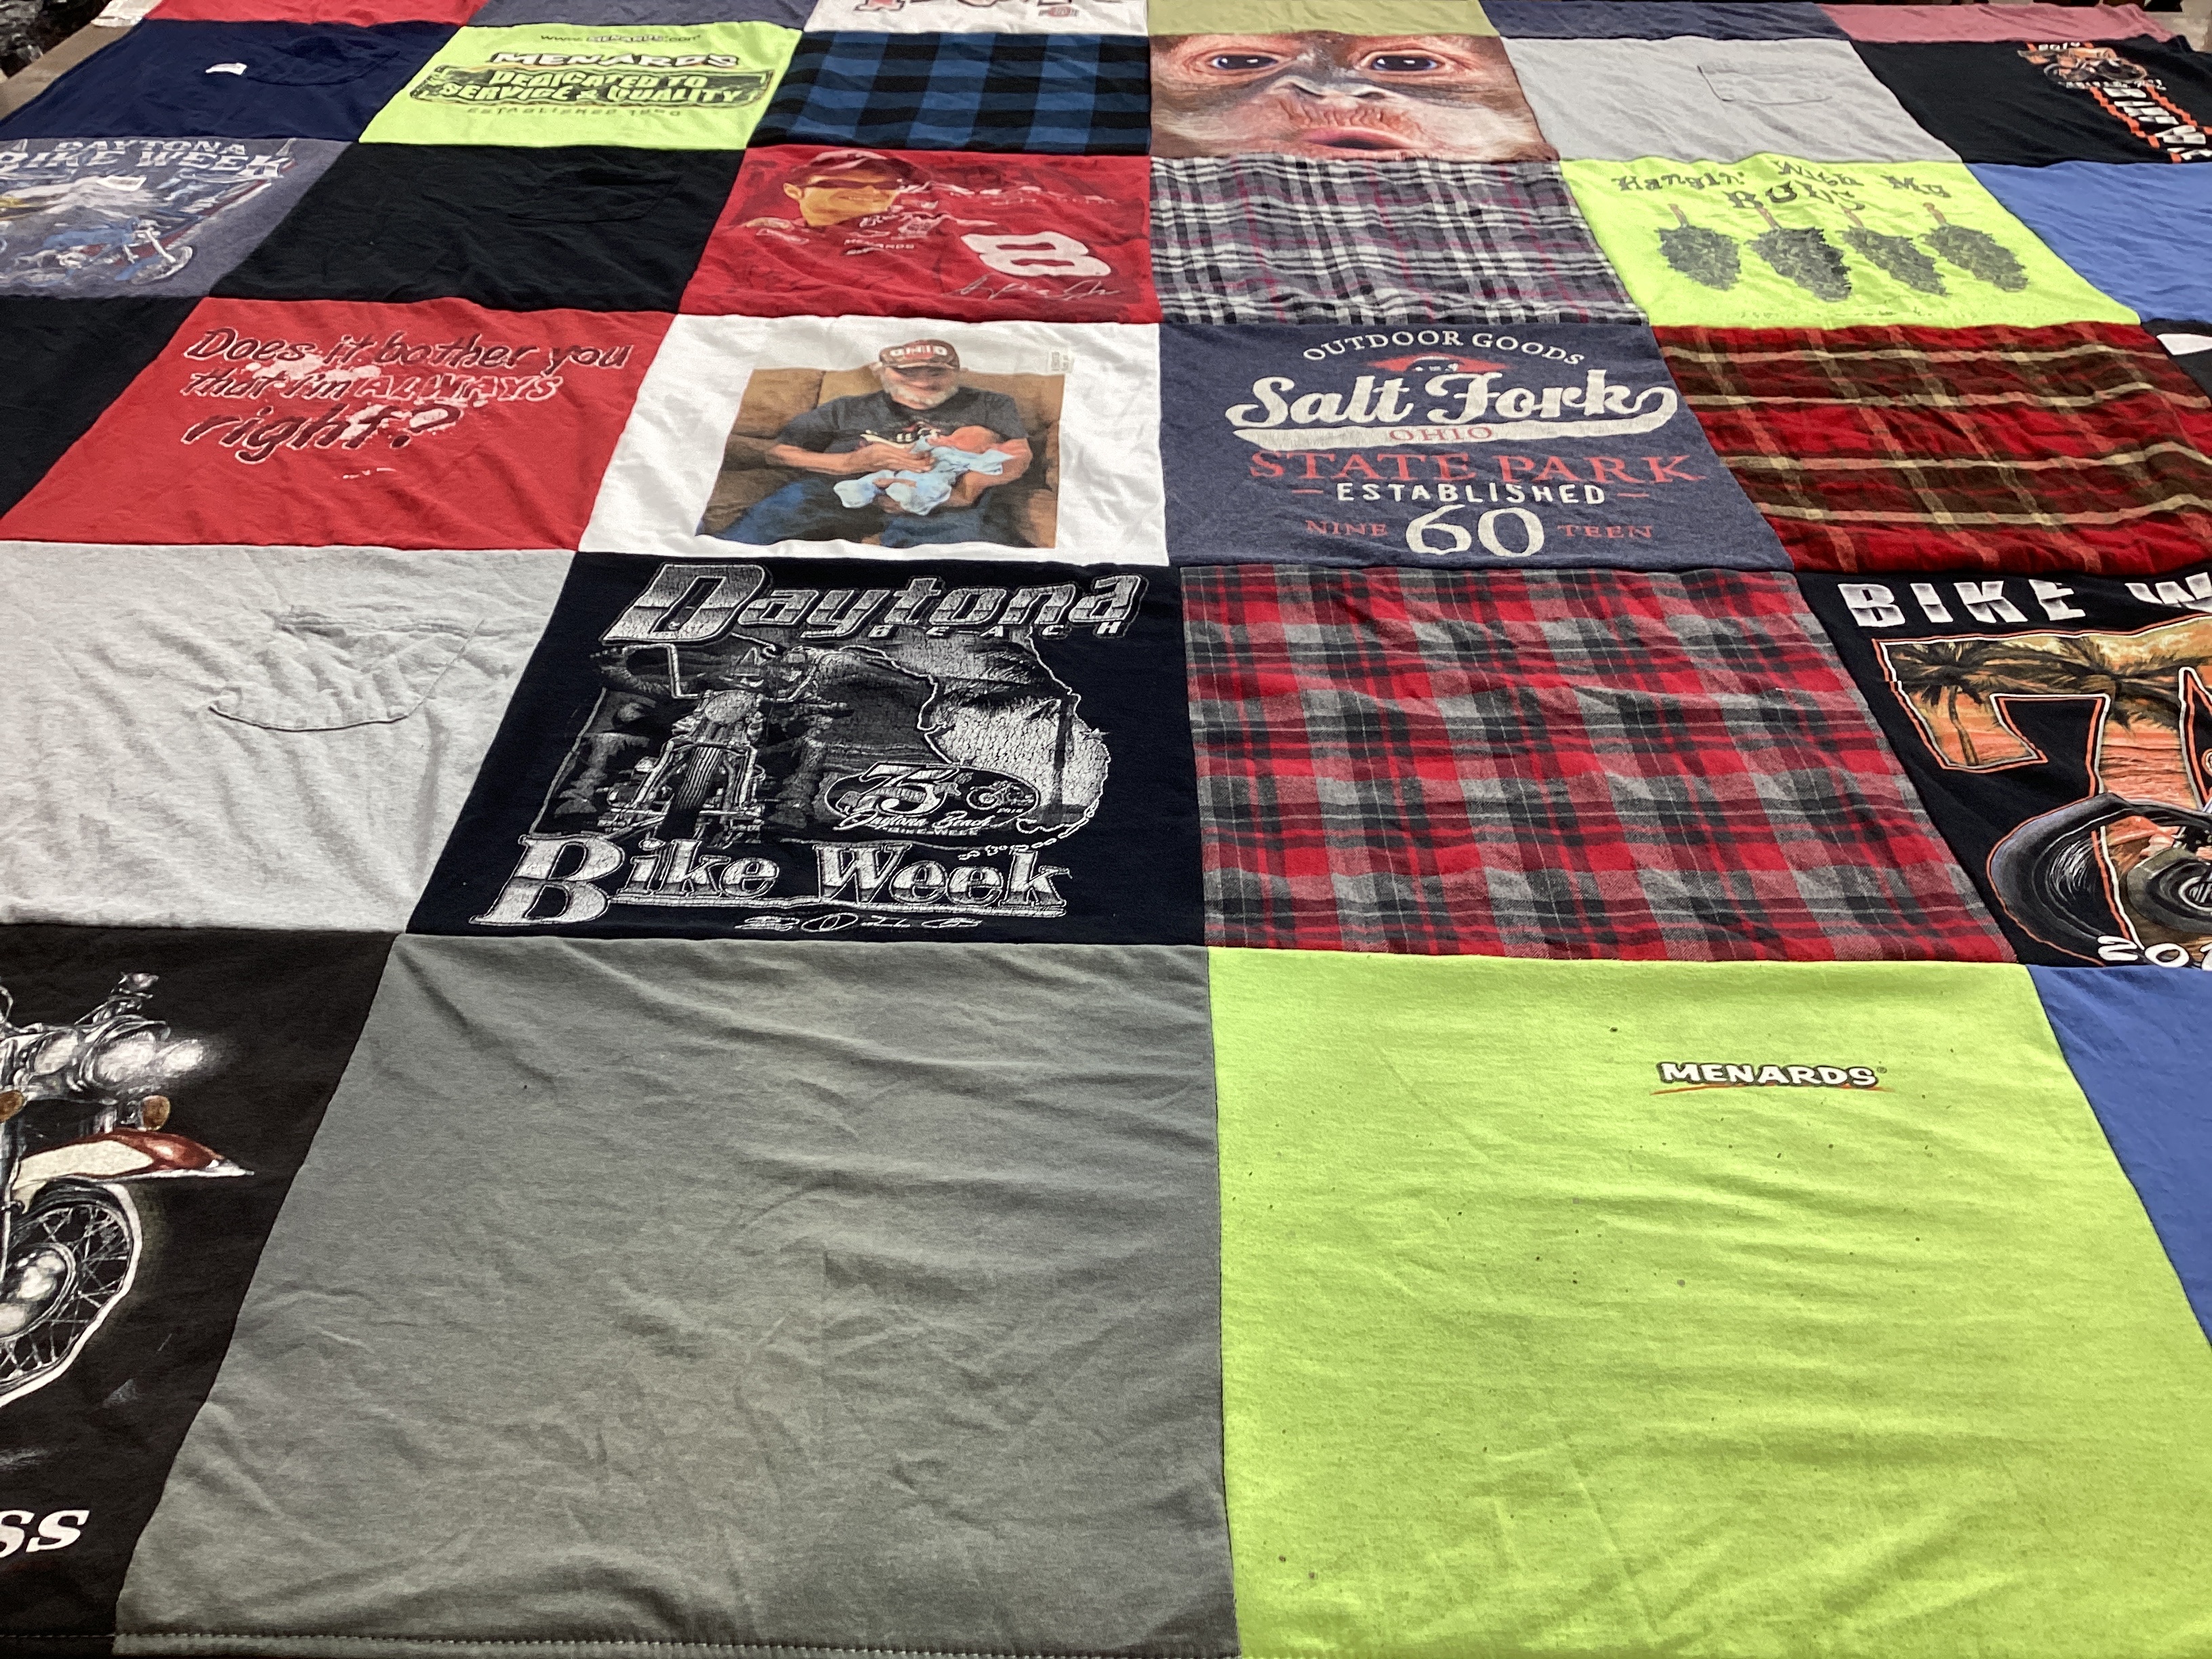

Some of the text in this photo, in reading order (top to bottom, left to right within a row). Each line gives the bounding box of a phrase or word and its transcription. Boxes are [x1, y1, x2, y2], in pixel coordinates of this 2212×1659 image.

[489, 52, 739, 67] MENARDS
[440, 82, 574, 100] SERVICE
[607, 85, 741, 102] QUALITY
[489, 69, 708, 88] DEDICATED TO
[54, 140, 246, 155] DAYTONA
[136, 150, 289, 178] WEEK
[1881, 174, 1952, 199] My
[960, 231, 1111, 277] 8
[184, 327, 634, 377] Does it bother you
[1303, 330, 1585, 365] OUTDOOR GOODS
[181, 368, 283, 398] that
[354, 372, 565, 404] ALWAYS
[1225, 369, 1667, 428] Salt Fork
[181, 403, 465, 465] right?
[1389, 426, 1493, 443] OHIO
[1250, 450, 1706, 485] STATE PARK
[1336, 482, 1606, 505] ESTABLISHED
[1305, 504, 1654, 558] NINE 60 TEEN
[597, 562, 1150, 645] Daytona
[1837, 578, 2086, 628] BIKE
[469, 834, 1071, 926] Bike Week
[1656, 1061, 1879, 1088] MENARDS
